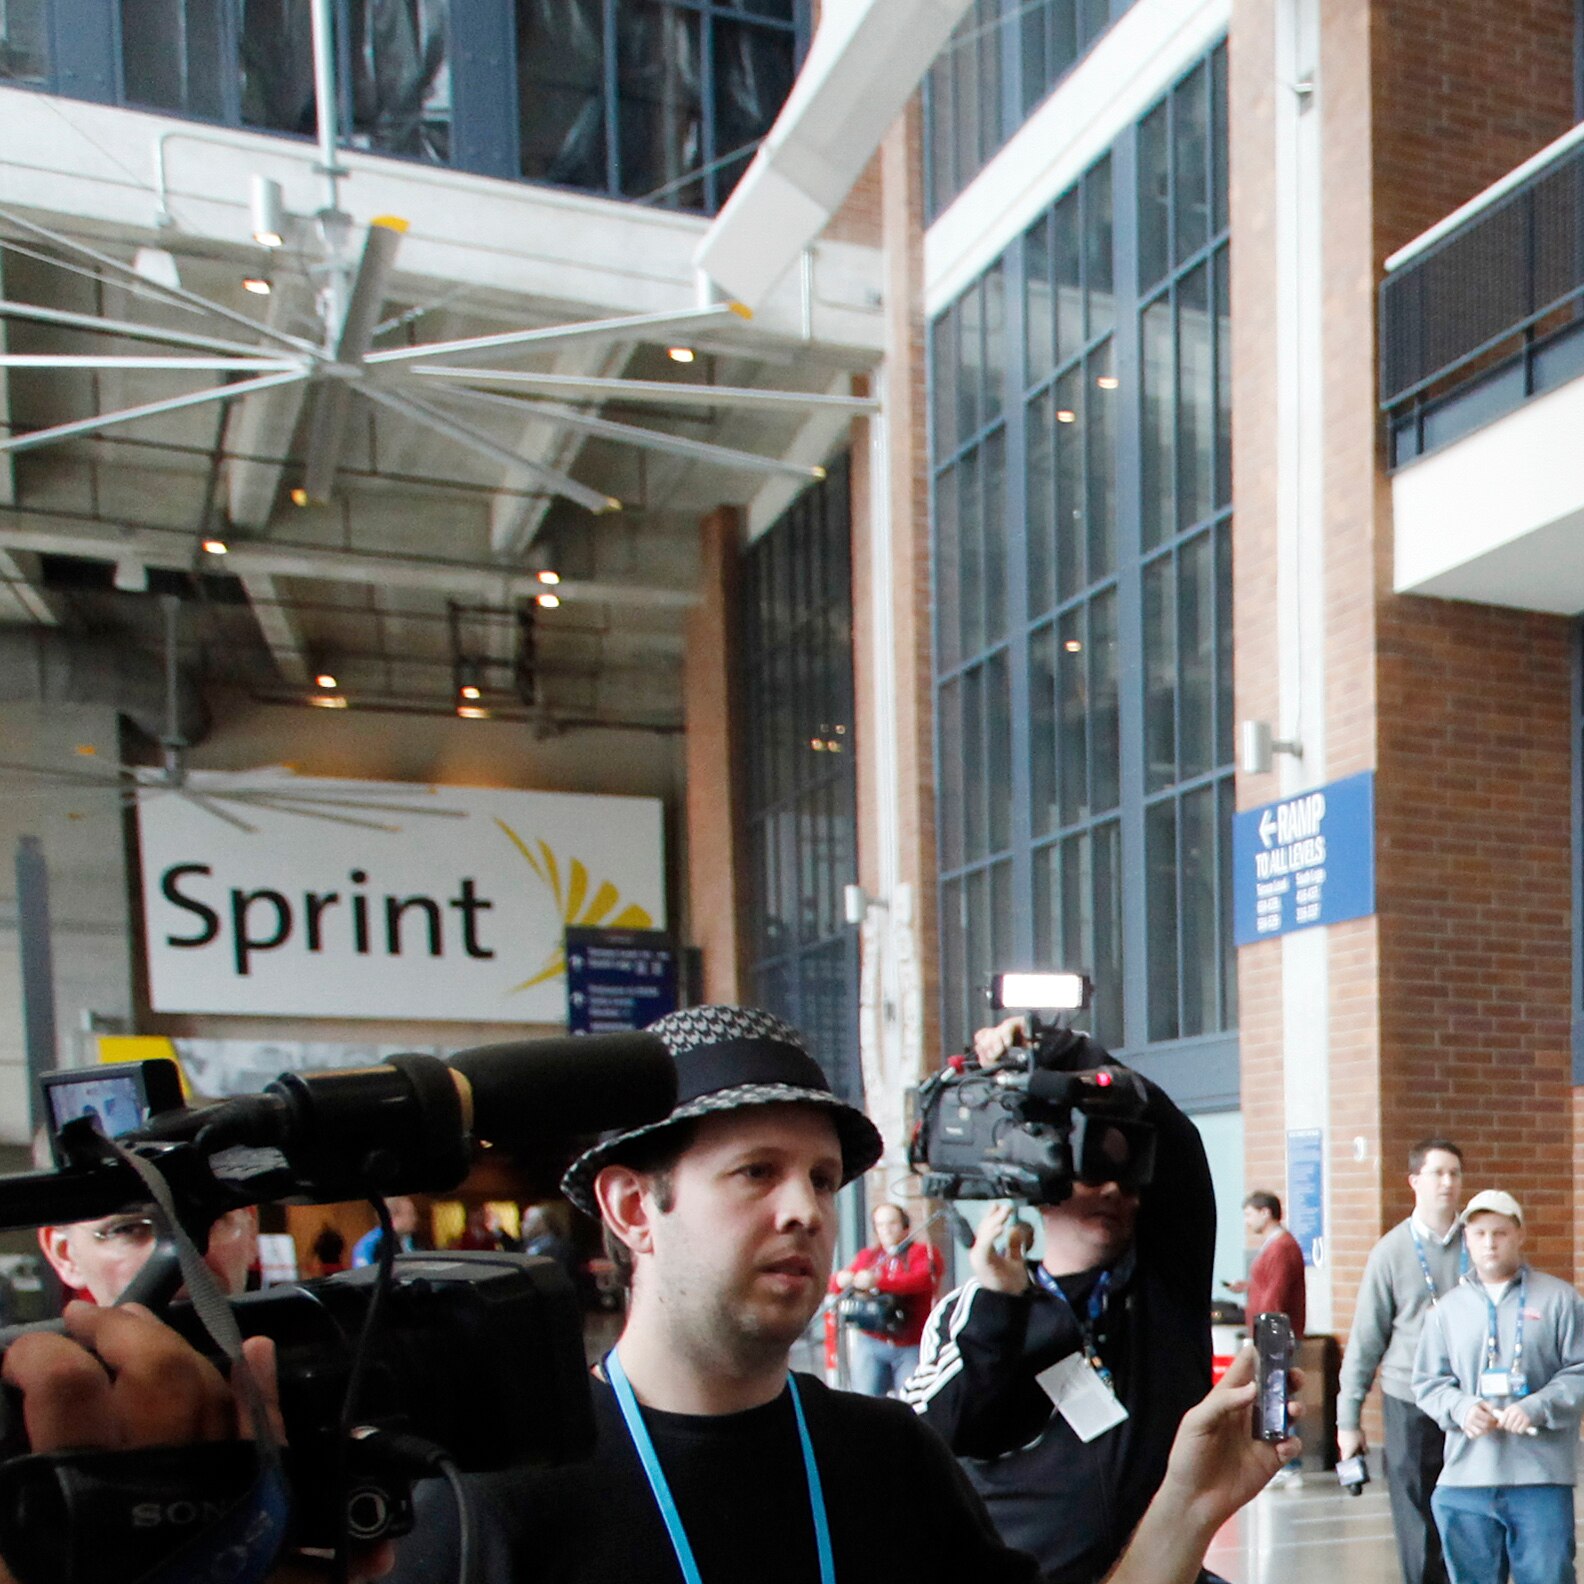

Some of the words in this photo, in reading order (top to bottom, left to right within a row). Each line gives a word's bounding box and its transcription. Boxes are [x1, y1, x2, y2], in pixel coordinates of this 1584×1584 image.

[1277, 792, 1327, 846] RAMP
[1255, 851, 1270, 878] TO
[1269, 846, 1288, 875] ALL
[1288, 835, 1327, 873] LEVELS
[159, 861, 497, 976] Sprint
